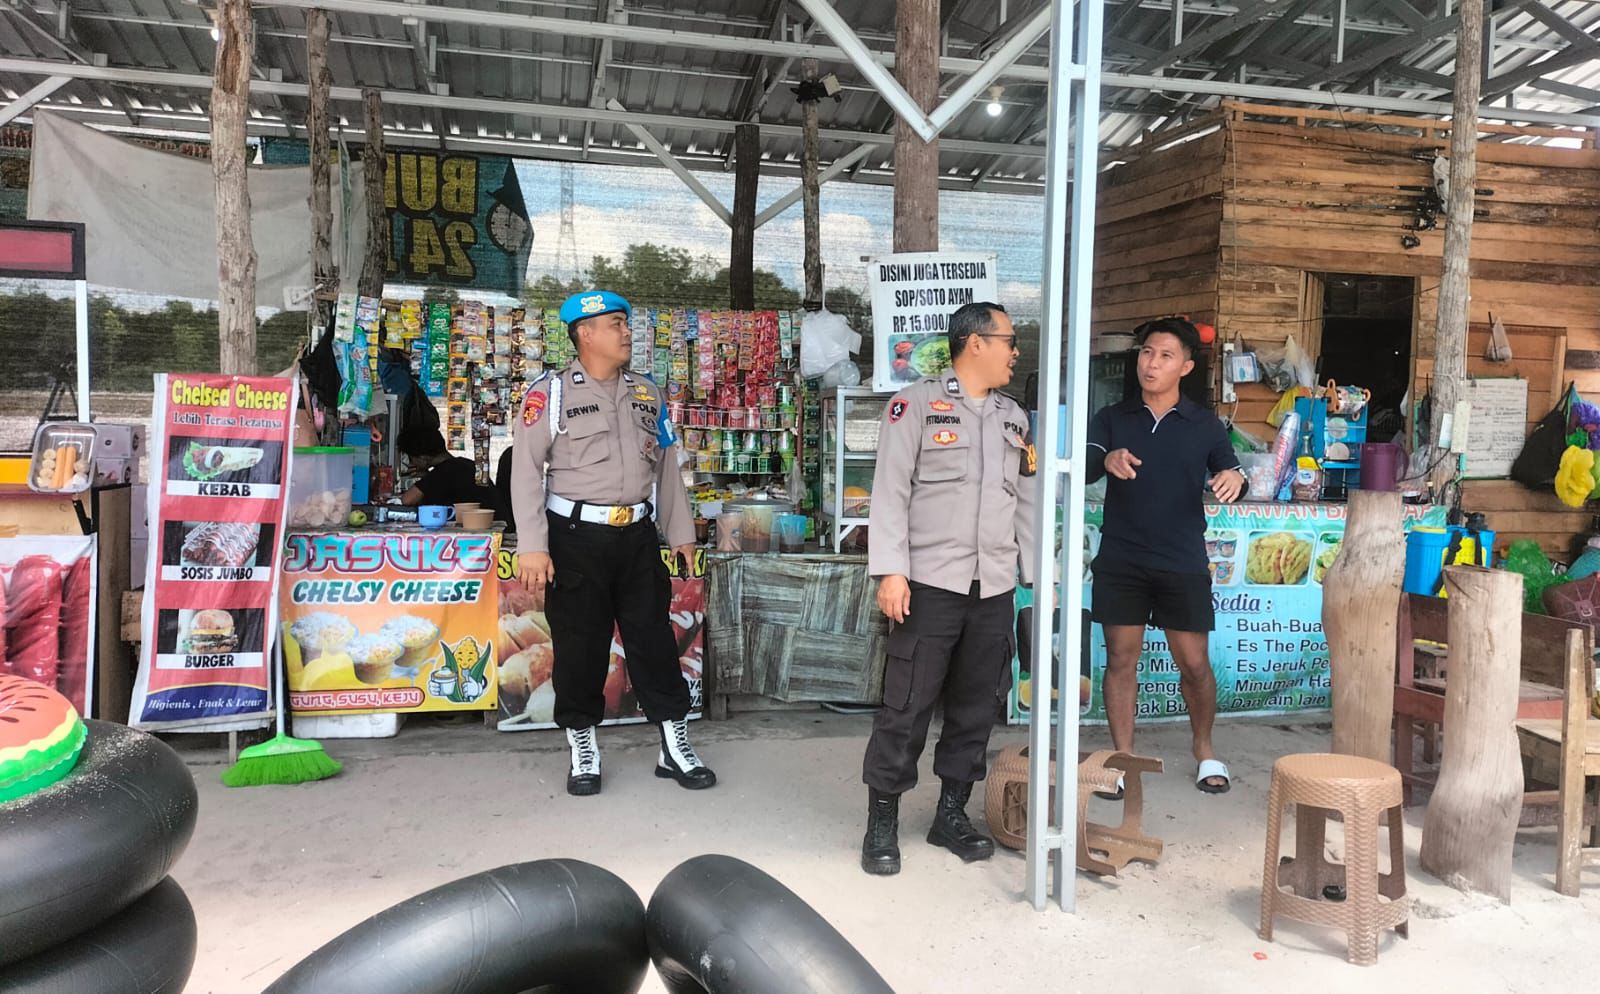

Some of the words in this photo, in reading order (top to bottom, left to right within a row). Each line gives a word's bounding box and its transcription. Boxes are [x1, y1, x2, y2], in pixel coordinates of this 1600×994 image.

[880, 264, 911, 282] DISINI
[914, 263, 939, 280] JUGA
[940, 262, 986, 280] TERSEDIA
[895, 288, 945, 307] SOP/SOTO
[948, 287, 974, 305] AYAM
[893, 316, 908, 333] RP.
[909, 313, 953, 331] 15.000/
[172, 379, 230, 407] Chelsea
[235, 383, 287, 410] Cheese
[566, 404, 600, 418] ERWIN
[174, 411, 201, 425] Lebih
[205, 413, 236, 427] Terasa
[198, 483, 251, 497] KEBAB
[284, 534, 492, 573] JASUKE
[181, 567, 214, 580] SOSIS
[217, 567, 253, 580] JUMBO
[293, 581, 385, 603] CHELSY
[389, 581, 481, 602] CHEESE
[1212, 592, 1261, 611] Sedia
[1237, 619, 1322, 632] Buah-Bua
[1237, 640, 1258, 652] Es
[1263, 640, 1294, 652] The
[1300, 640, 1328, 651] Poc
[184, 655, 234, 668] BURGER
[1237, 660, 1256, 672] Es
[1262, 660, 1306, 672] Jeruk
[1311, 658, 1329, 669] Pe
[1235, 679, 1303, 692] Minuman
[1309, 675, 1331, 688] Ha
[383, 692, 418, 703] KEJU
[1232, 698, 1262, 709] Dan
[1264, 695, 1293, 707] lain
[1299, 694, 1326, 706] lain
